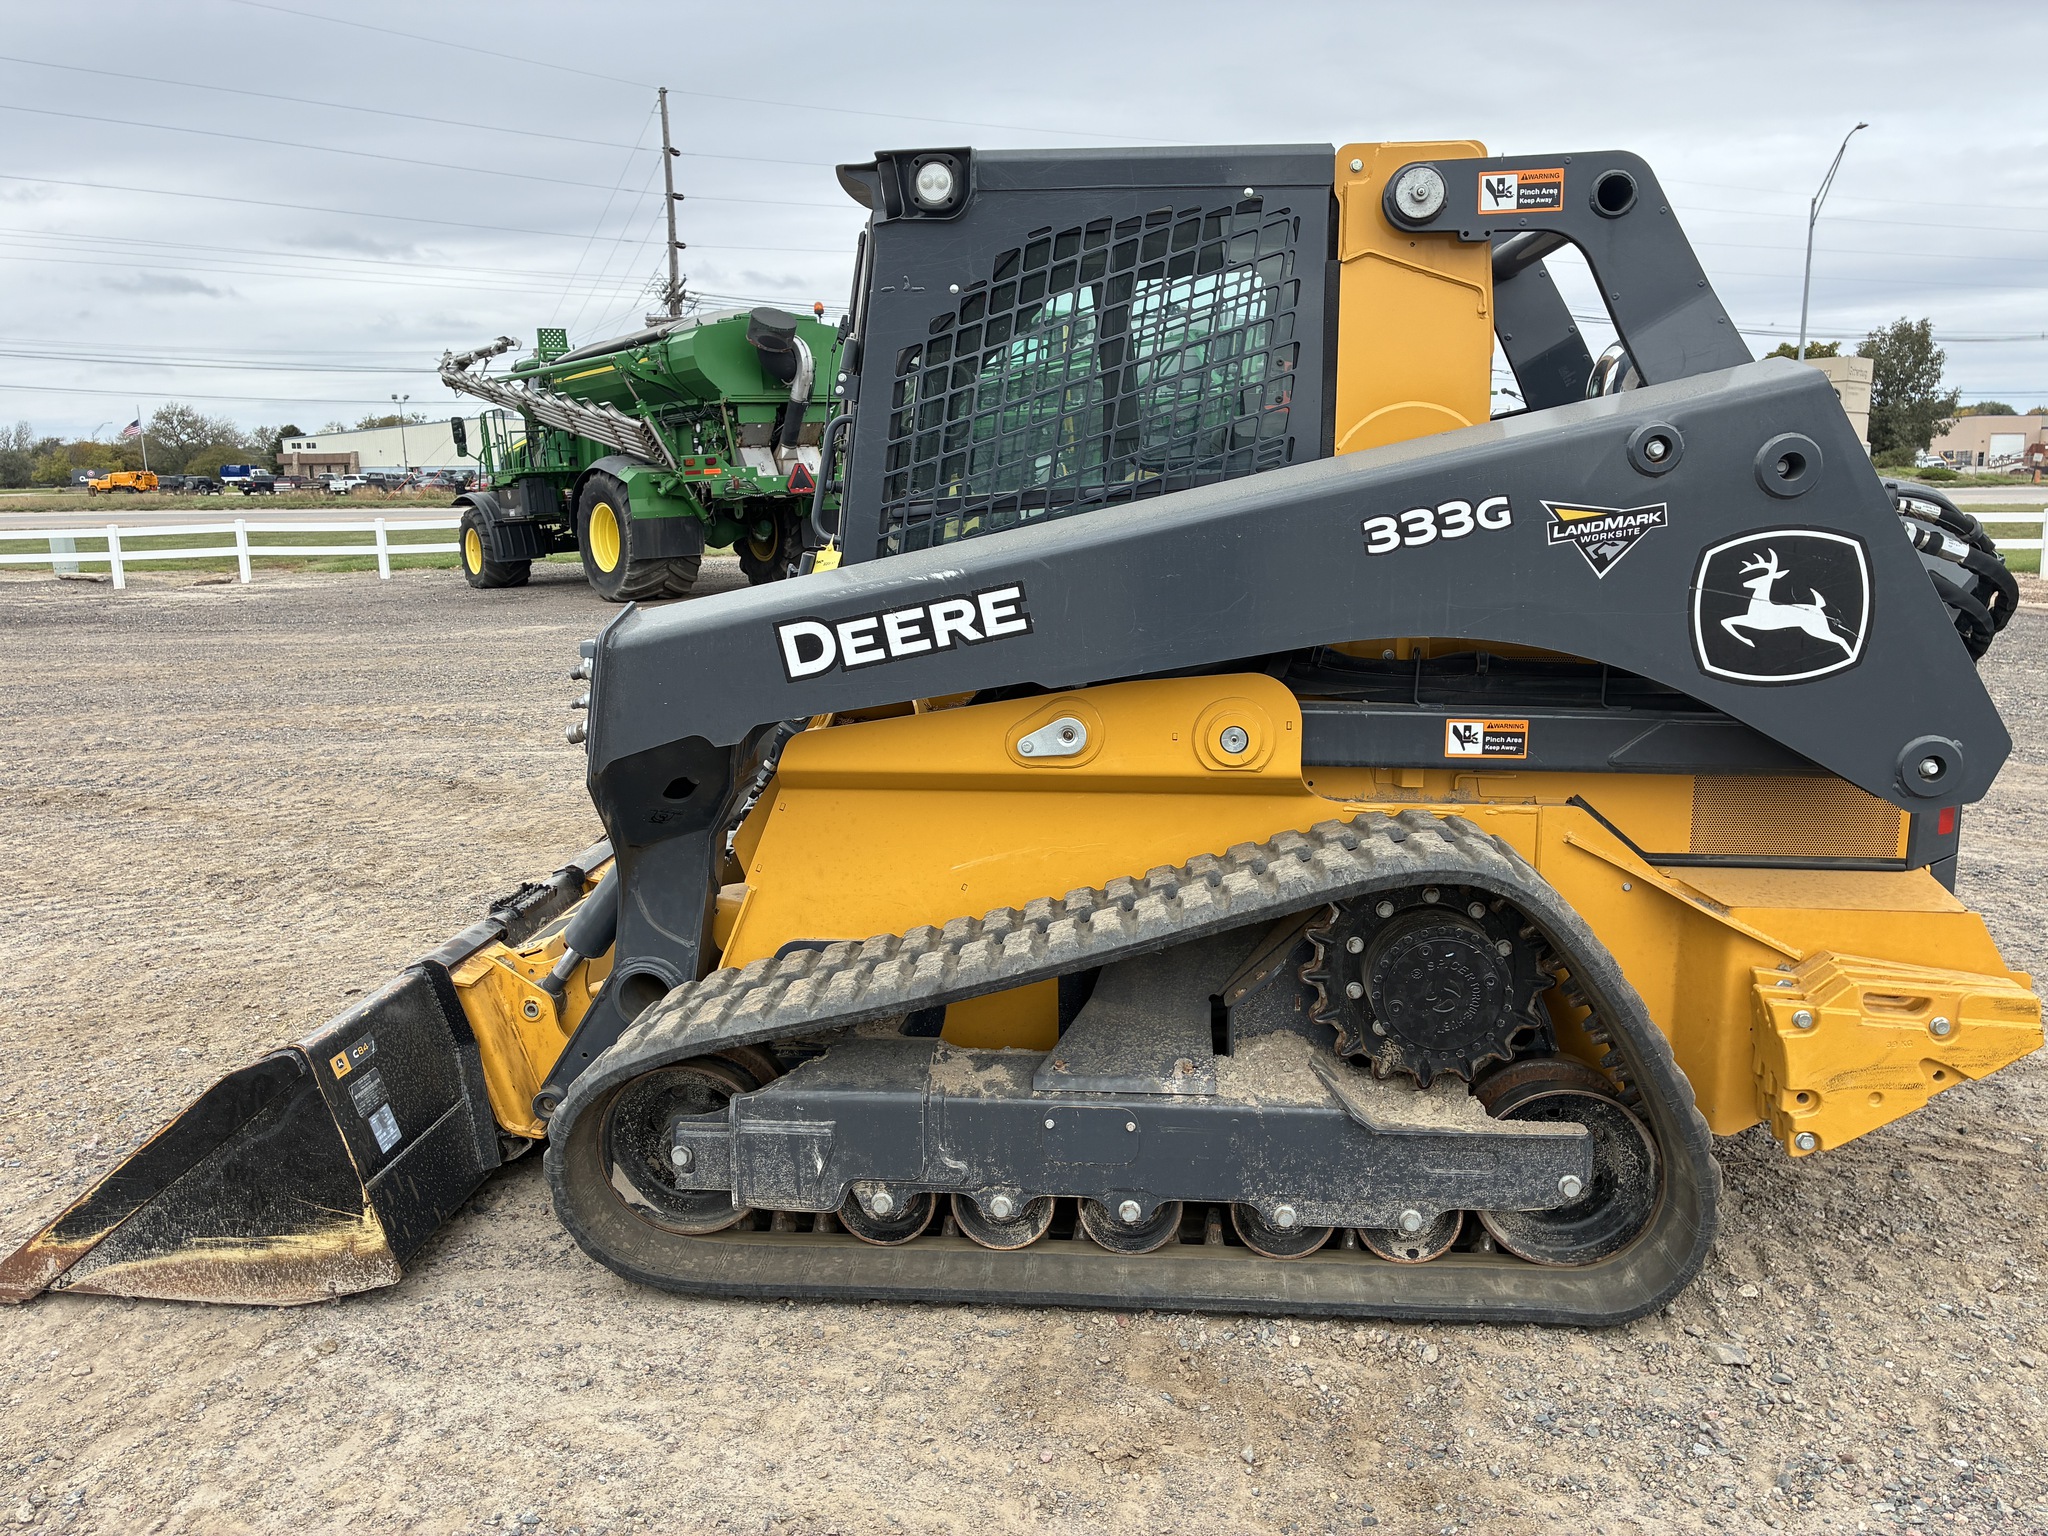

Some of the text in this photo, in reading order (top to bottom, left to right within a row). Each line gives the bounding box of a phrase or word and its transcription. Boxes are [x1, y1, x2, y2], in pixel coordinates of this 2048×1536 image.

[1541, 187, 1558, 195] Area
[1363, 496, 1512, 554] 333G
[1553, 510, 1662, 538] LANDMARK
[1580, 527, 1641, 543] WORKSITE
[778, 586, 1028, 678] DEERE
[352, 1042, 369, 1059] C84
